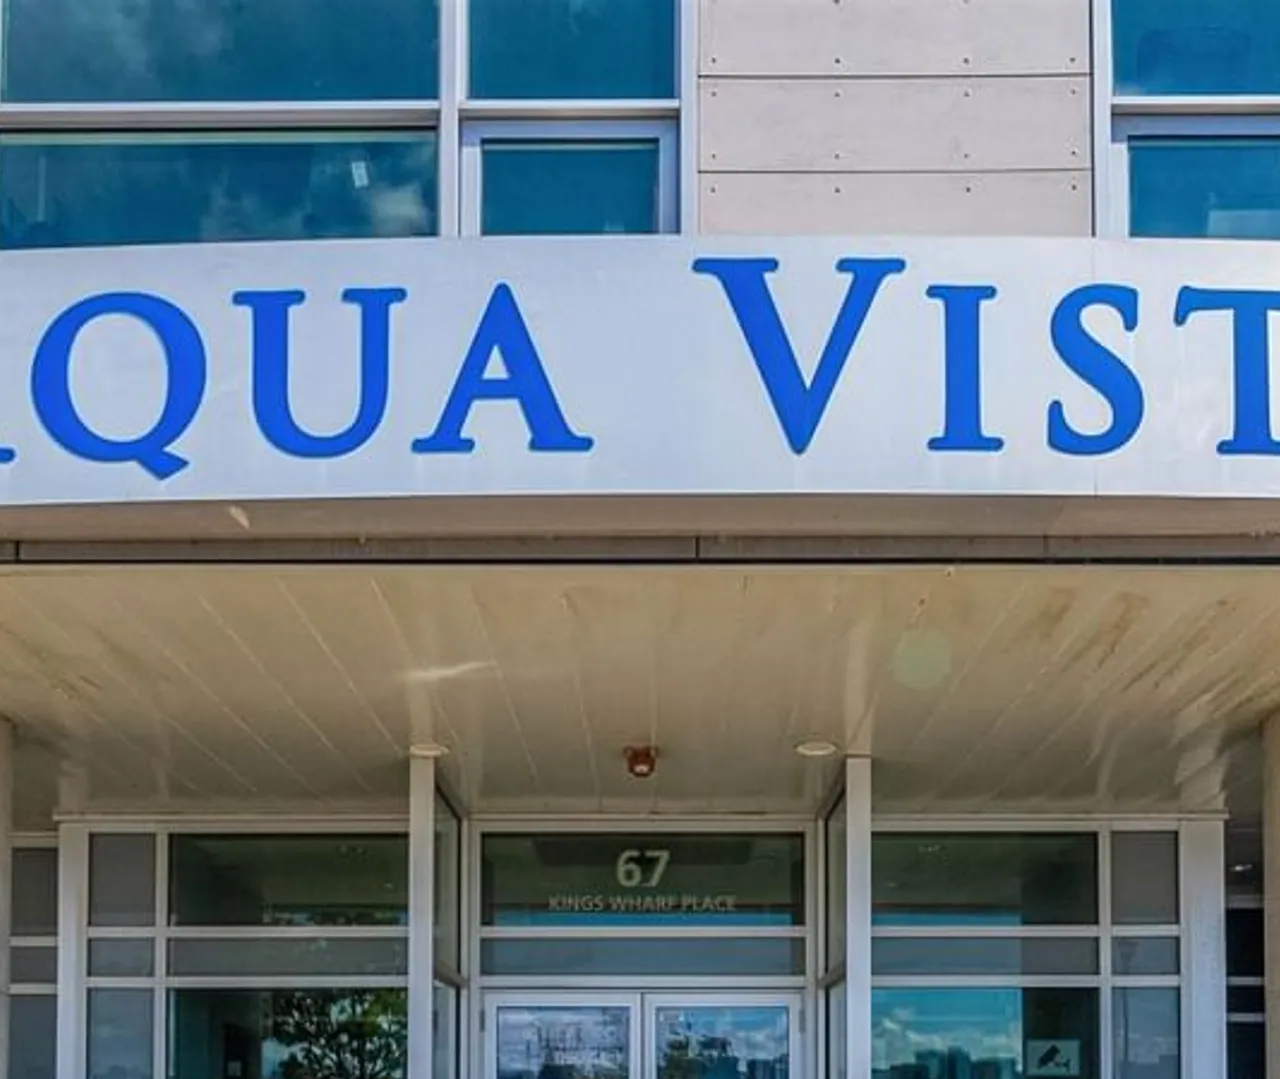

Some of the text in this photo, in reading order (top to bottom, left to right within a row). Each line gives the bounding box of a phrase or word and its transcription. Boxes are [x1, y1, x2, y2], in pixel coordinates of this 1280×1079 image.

[616, 849, 670, 887] 67
[548, 895, 604, 912] KINGS
[681, 895, 737, 912] PLACE
